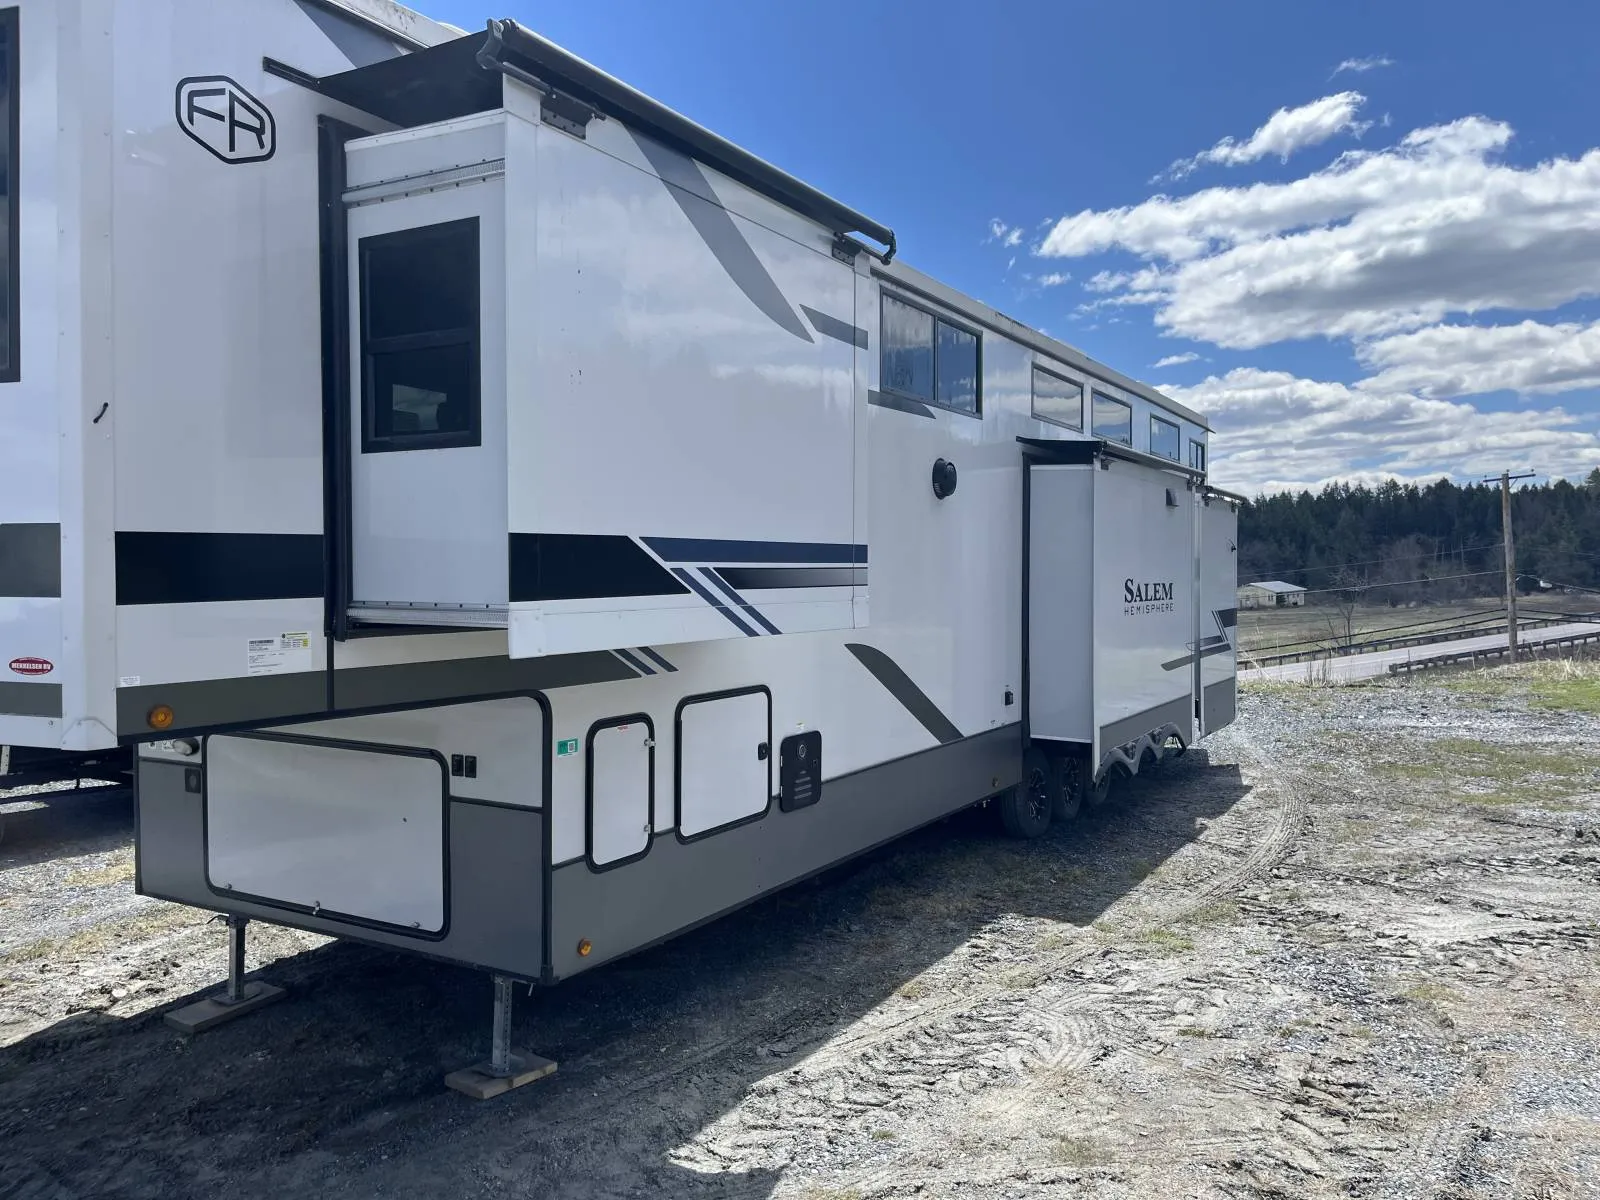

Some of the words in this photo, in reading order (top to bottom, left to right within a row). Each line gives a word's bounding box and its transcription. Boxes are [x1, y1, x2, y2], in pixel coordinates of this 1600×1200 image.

[187, 87, 266, 153] FR
[1124, 578, 1174, 603] SALEM
[1124, 603, 1174, 616] HEMISPHERE
